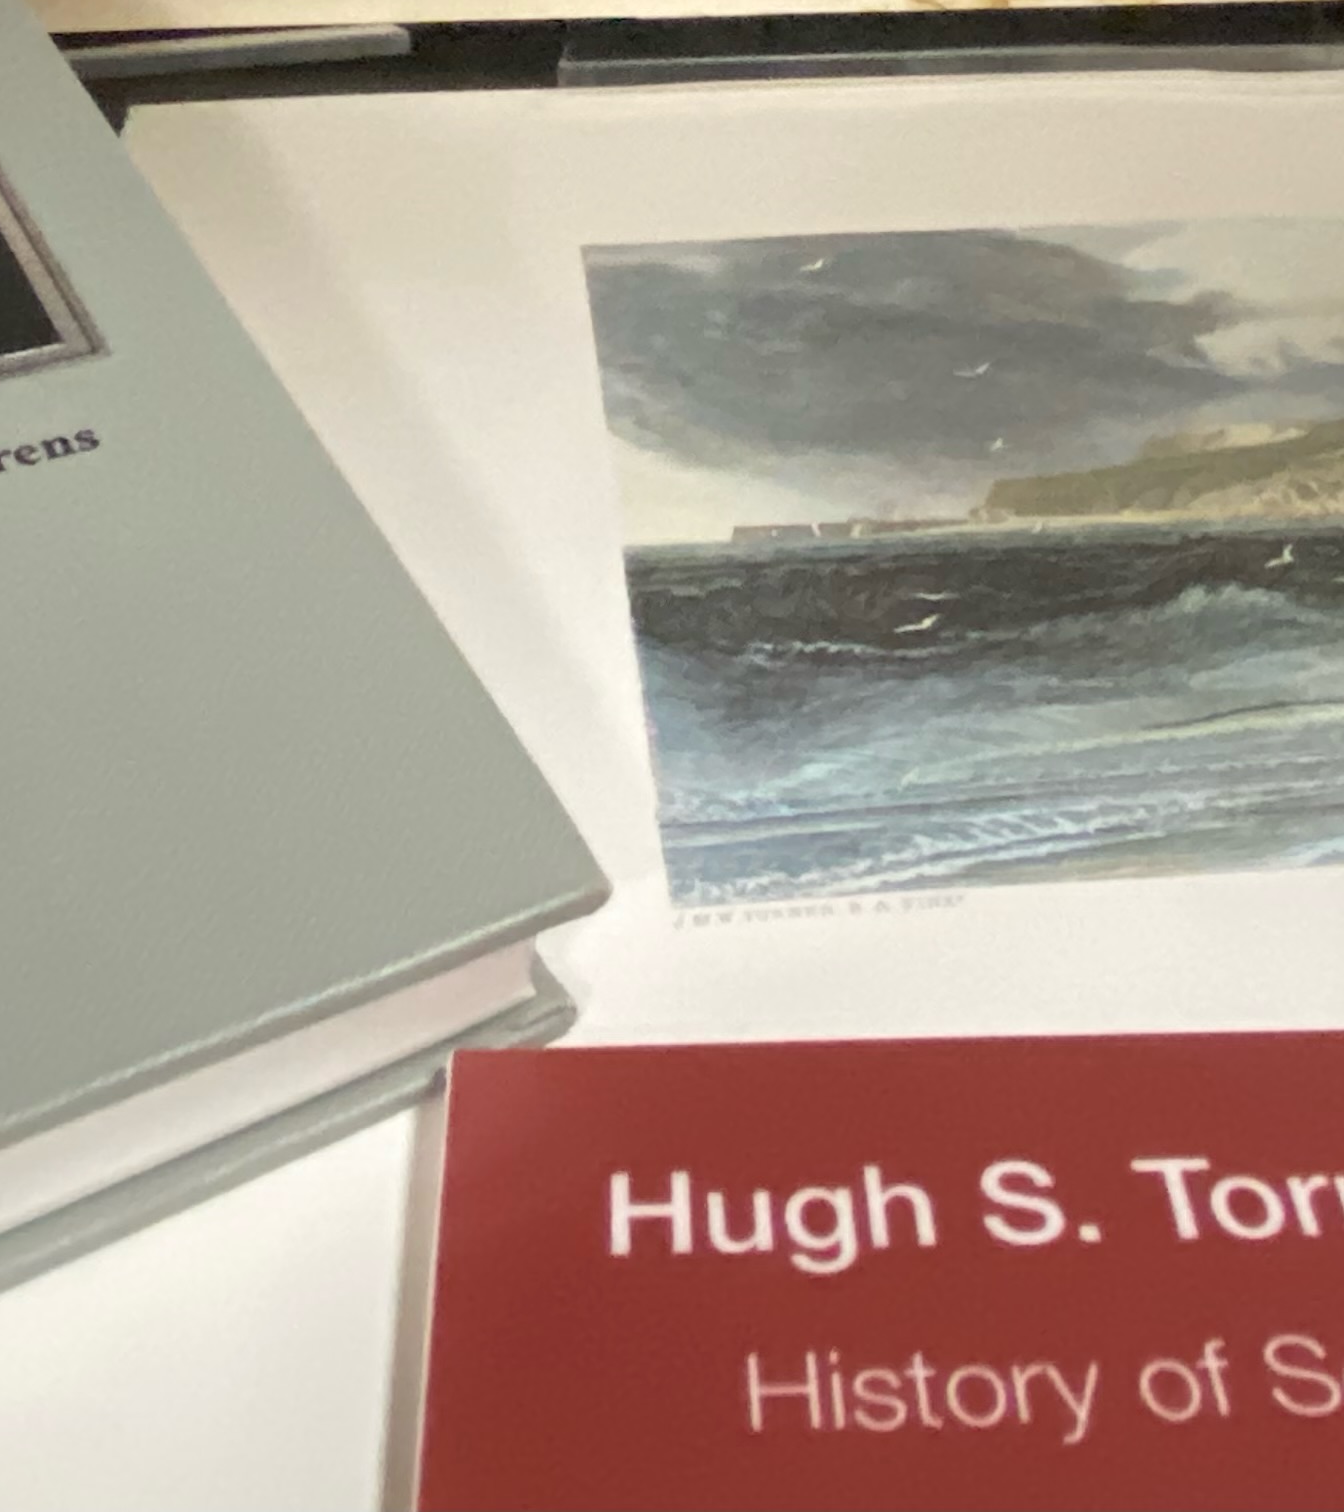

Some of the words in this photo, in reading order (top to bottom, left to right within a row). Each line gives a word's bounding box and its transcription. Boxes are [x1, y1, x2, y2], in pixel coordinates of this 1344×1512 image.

[608, 1162, 938, 1276] Hugh
[978, 1158, 1102, 1245] S.
[745, 1347, 1098, 1446] History
[1137, 1338, 1231, 1423] of
